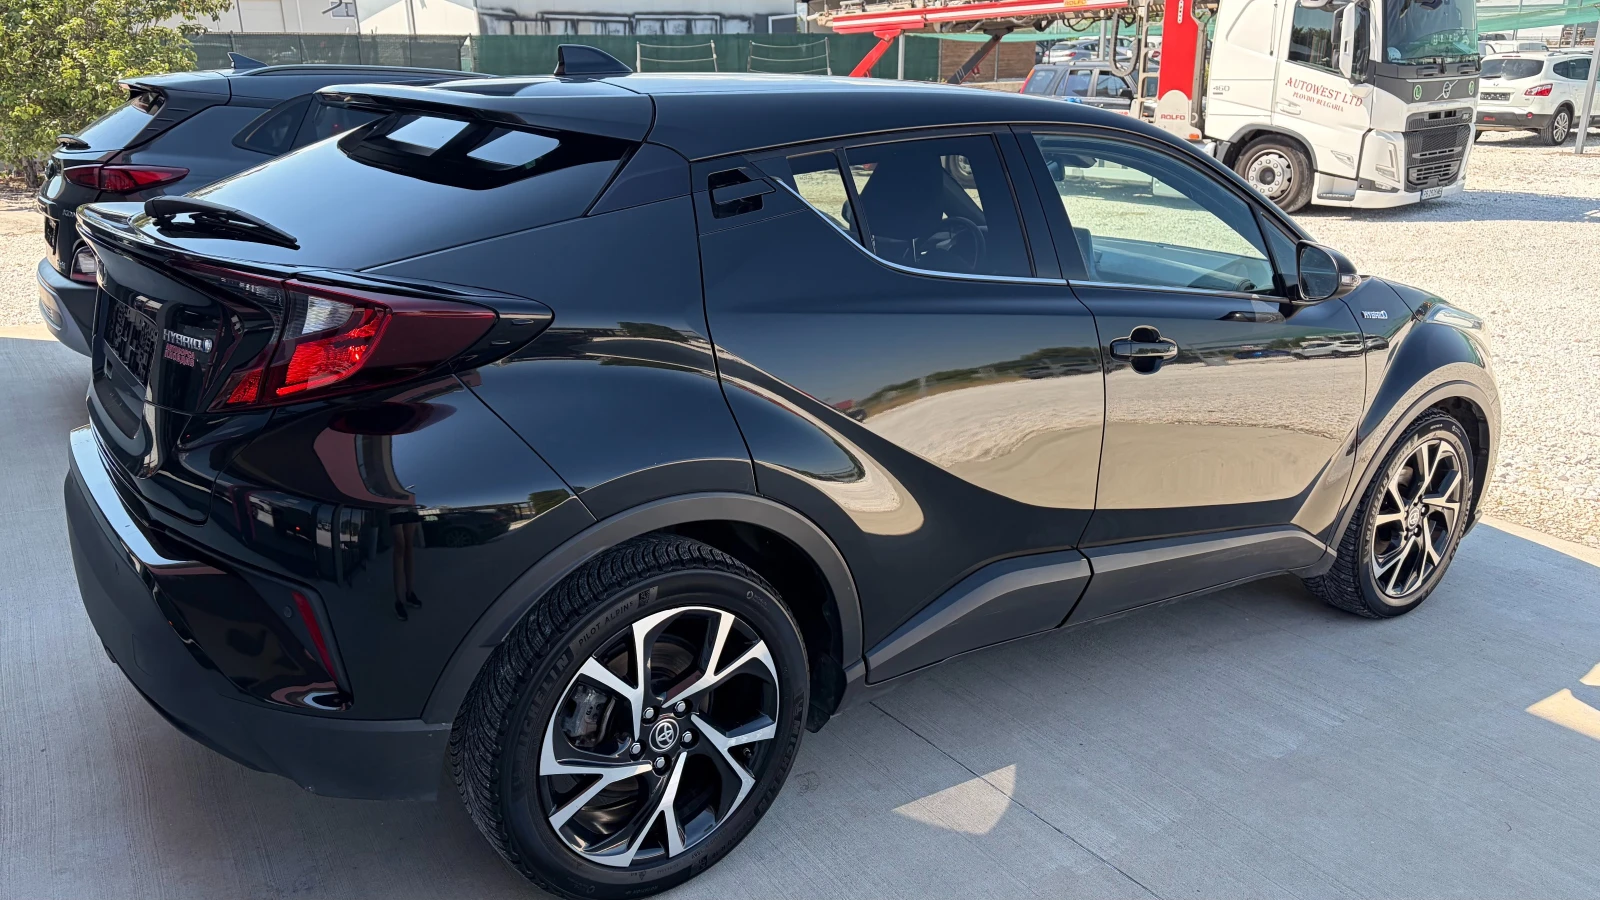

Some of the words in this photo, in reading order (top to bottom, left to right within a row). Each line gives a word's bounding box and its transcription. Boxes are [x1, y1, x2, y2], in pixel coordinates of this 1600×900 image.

[1285, 77, 1341, 100] AUTOWEST
[1342, 93, 1363, 107] LTD
[1316, 98, 1344, 112] BULGARIA
[1362, 310, 1383, 319] HYBRID
[163, 328, 202, 351] HYBRID
[578, 623, 601, 647] PILOT
[514, 653, 569, 763] MICHELIN
